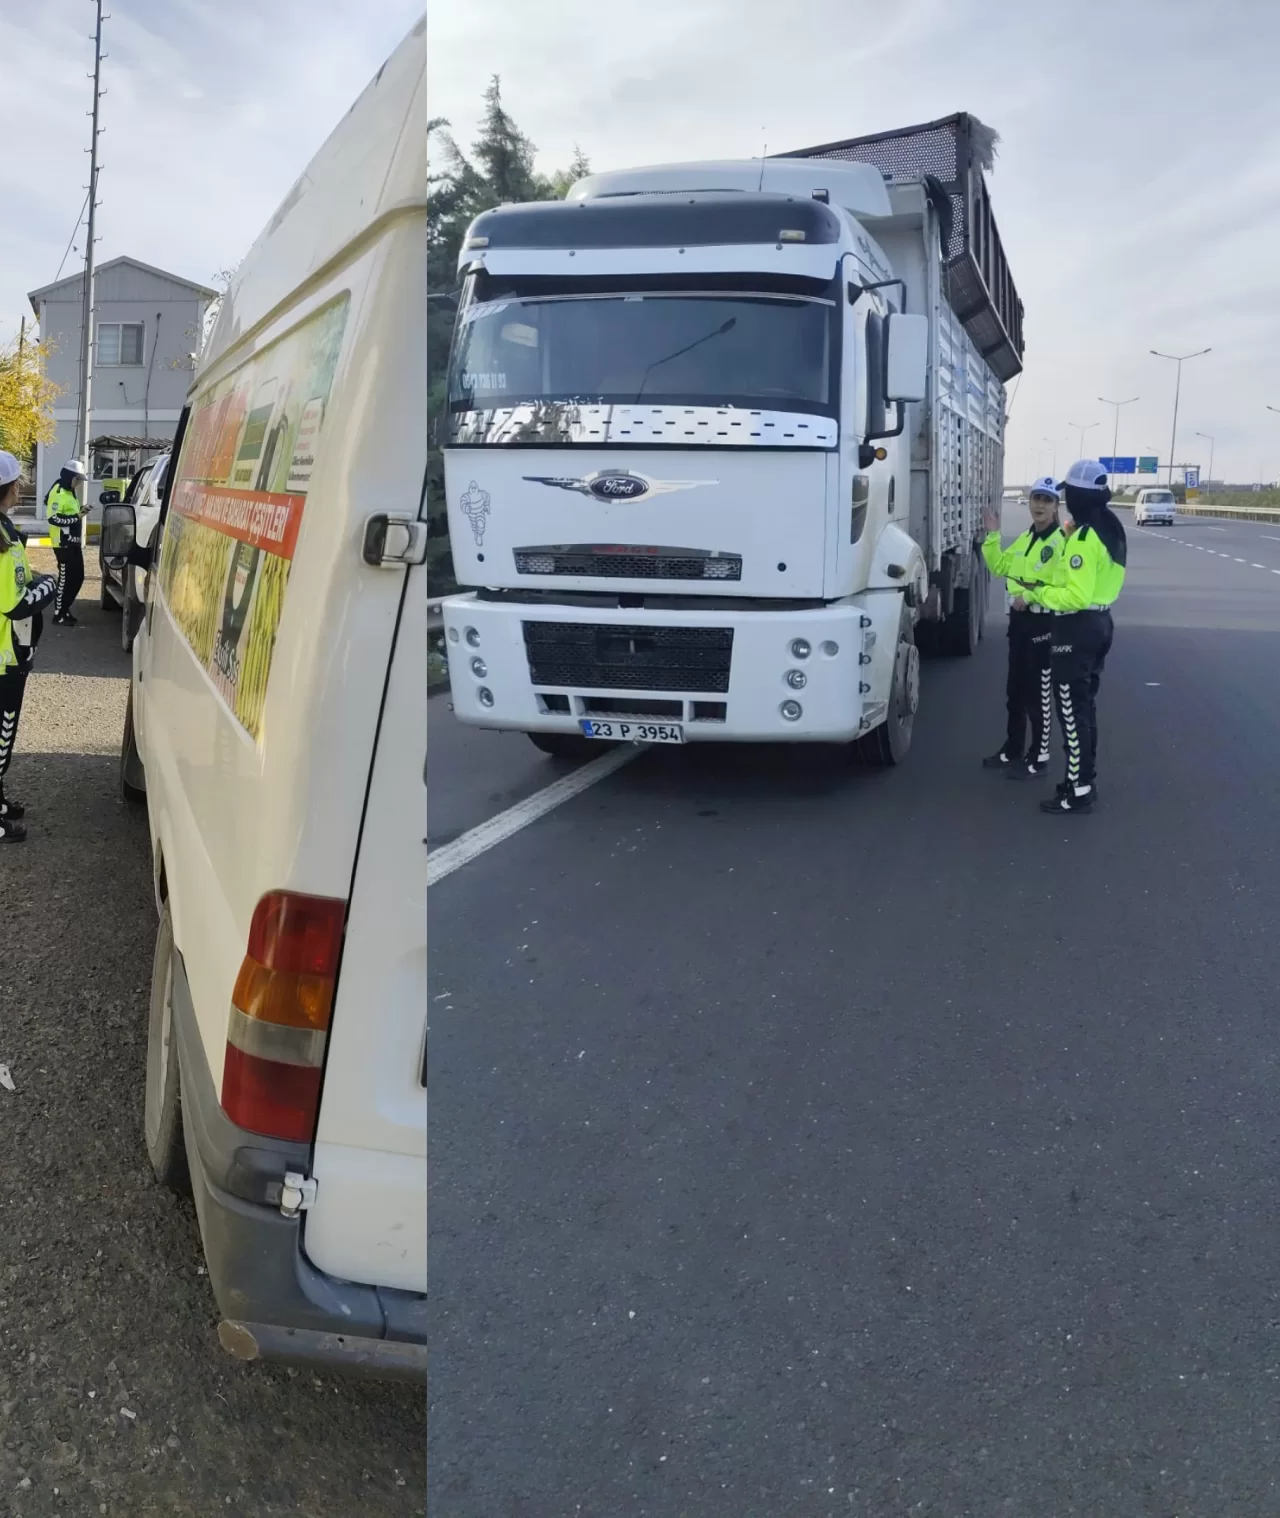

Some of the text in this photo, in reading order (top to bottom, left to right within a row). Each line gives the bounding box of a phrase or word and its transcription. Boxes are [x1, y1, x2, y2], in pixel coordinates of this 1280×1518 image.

[603, 480, 634, 494] Ford
[592, 723, 679, 741] 23 P 3954
